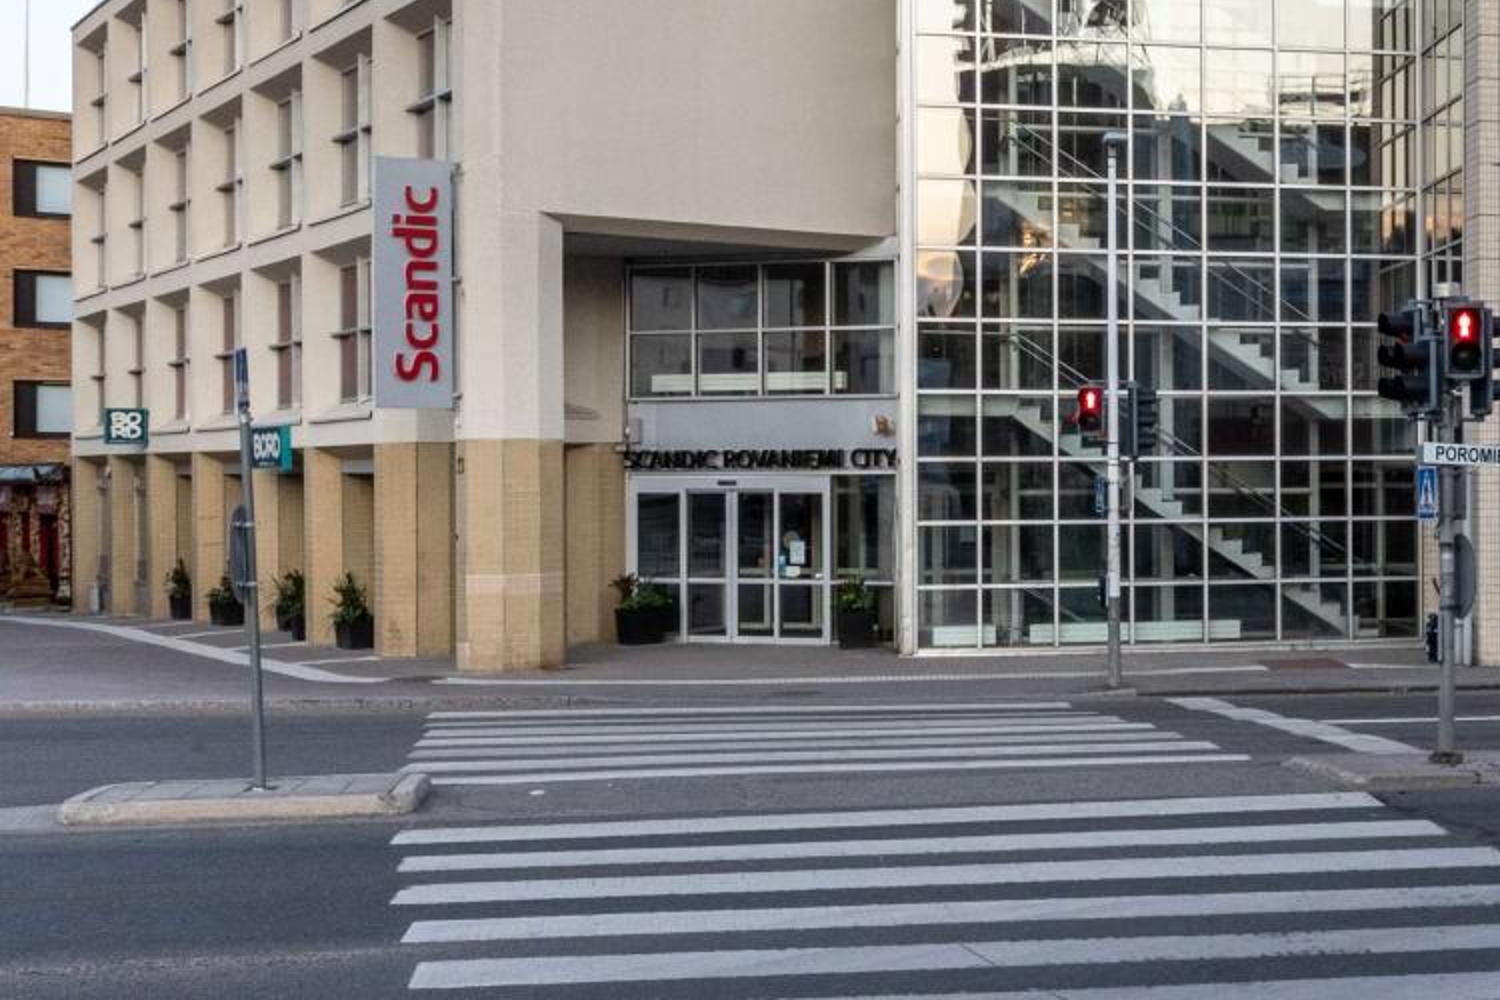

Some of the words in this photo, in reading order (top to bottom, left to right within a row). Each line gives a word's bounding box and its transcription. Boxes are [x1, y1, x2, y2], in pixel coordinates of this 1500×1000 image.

[393, 185, 440, 383] Scandic
[624, 449, 718, 469] SCANDIC
[723, 449, 843, 469] ROVANIEMI
[850, 448, 896, 469] CITY
